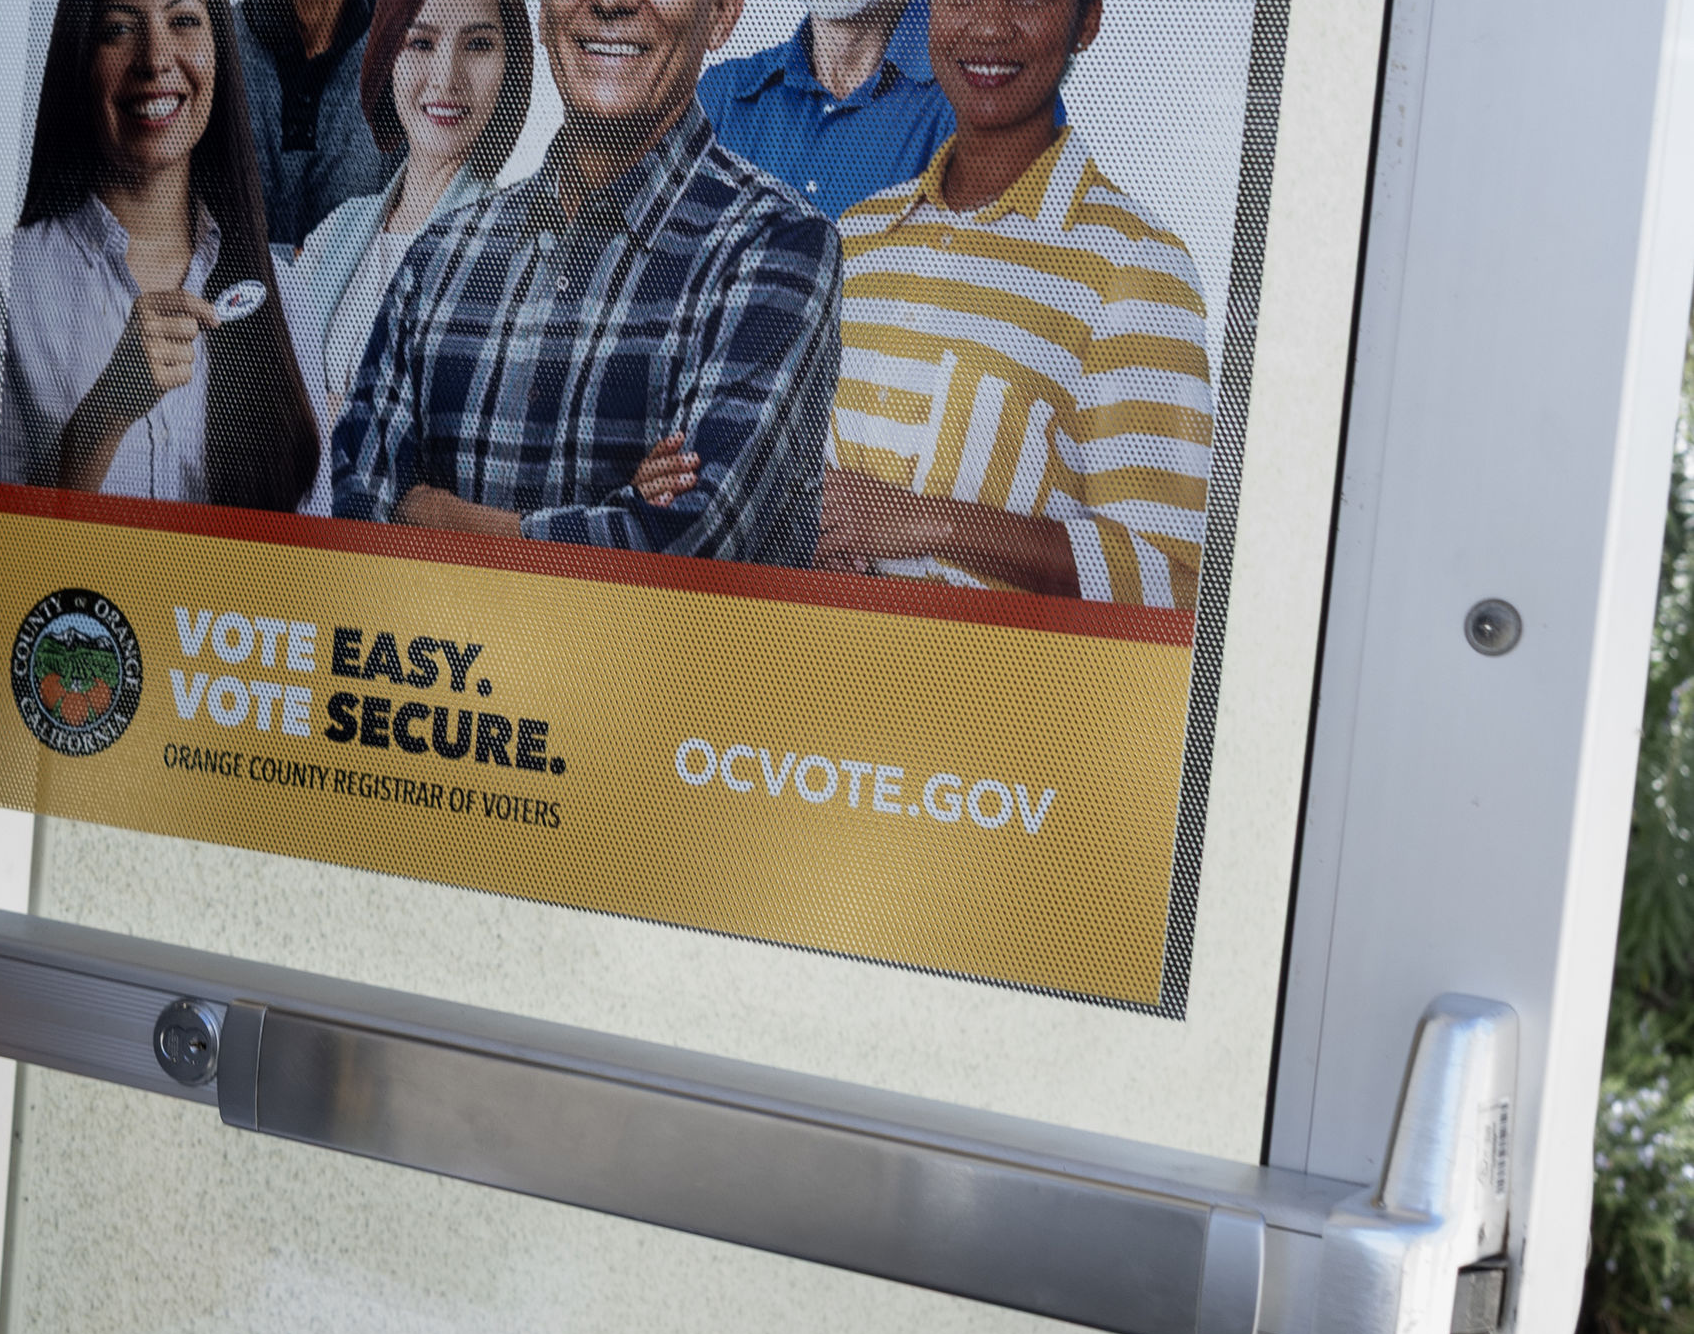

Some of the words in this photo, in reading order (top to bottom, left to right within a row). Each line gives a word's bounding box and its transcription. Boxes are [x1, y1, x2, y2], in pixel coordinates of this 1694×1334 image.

[13, 594, 63, 677] COUNTY
[94, 599, 140, 689] ORANGE
[173, 605, 317, 673] VOTE
[331, 626, 493, 697] EASY.
[19, 696, 129, 753] CALIFORNIA
[168, 668, 313, 738] VOTE
[324, 691, 568, 776] SECURE.
[163, 742, 244, 779] ORANGE
[249, 757, 331, 792] COUNTY
[332, 770, 444, 810] REGISTRAR
[448, 786, 478, 815] OF
[482, 794, 562, 829] VOTERS
[674, 737, 1057, 835] OCVOTE.GOV
